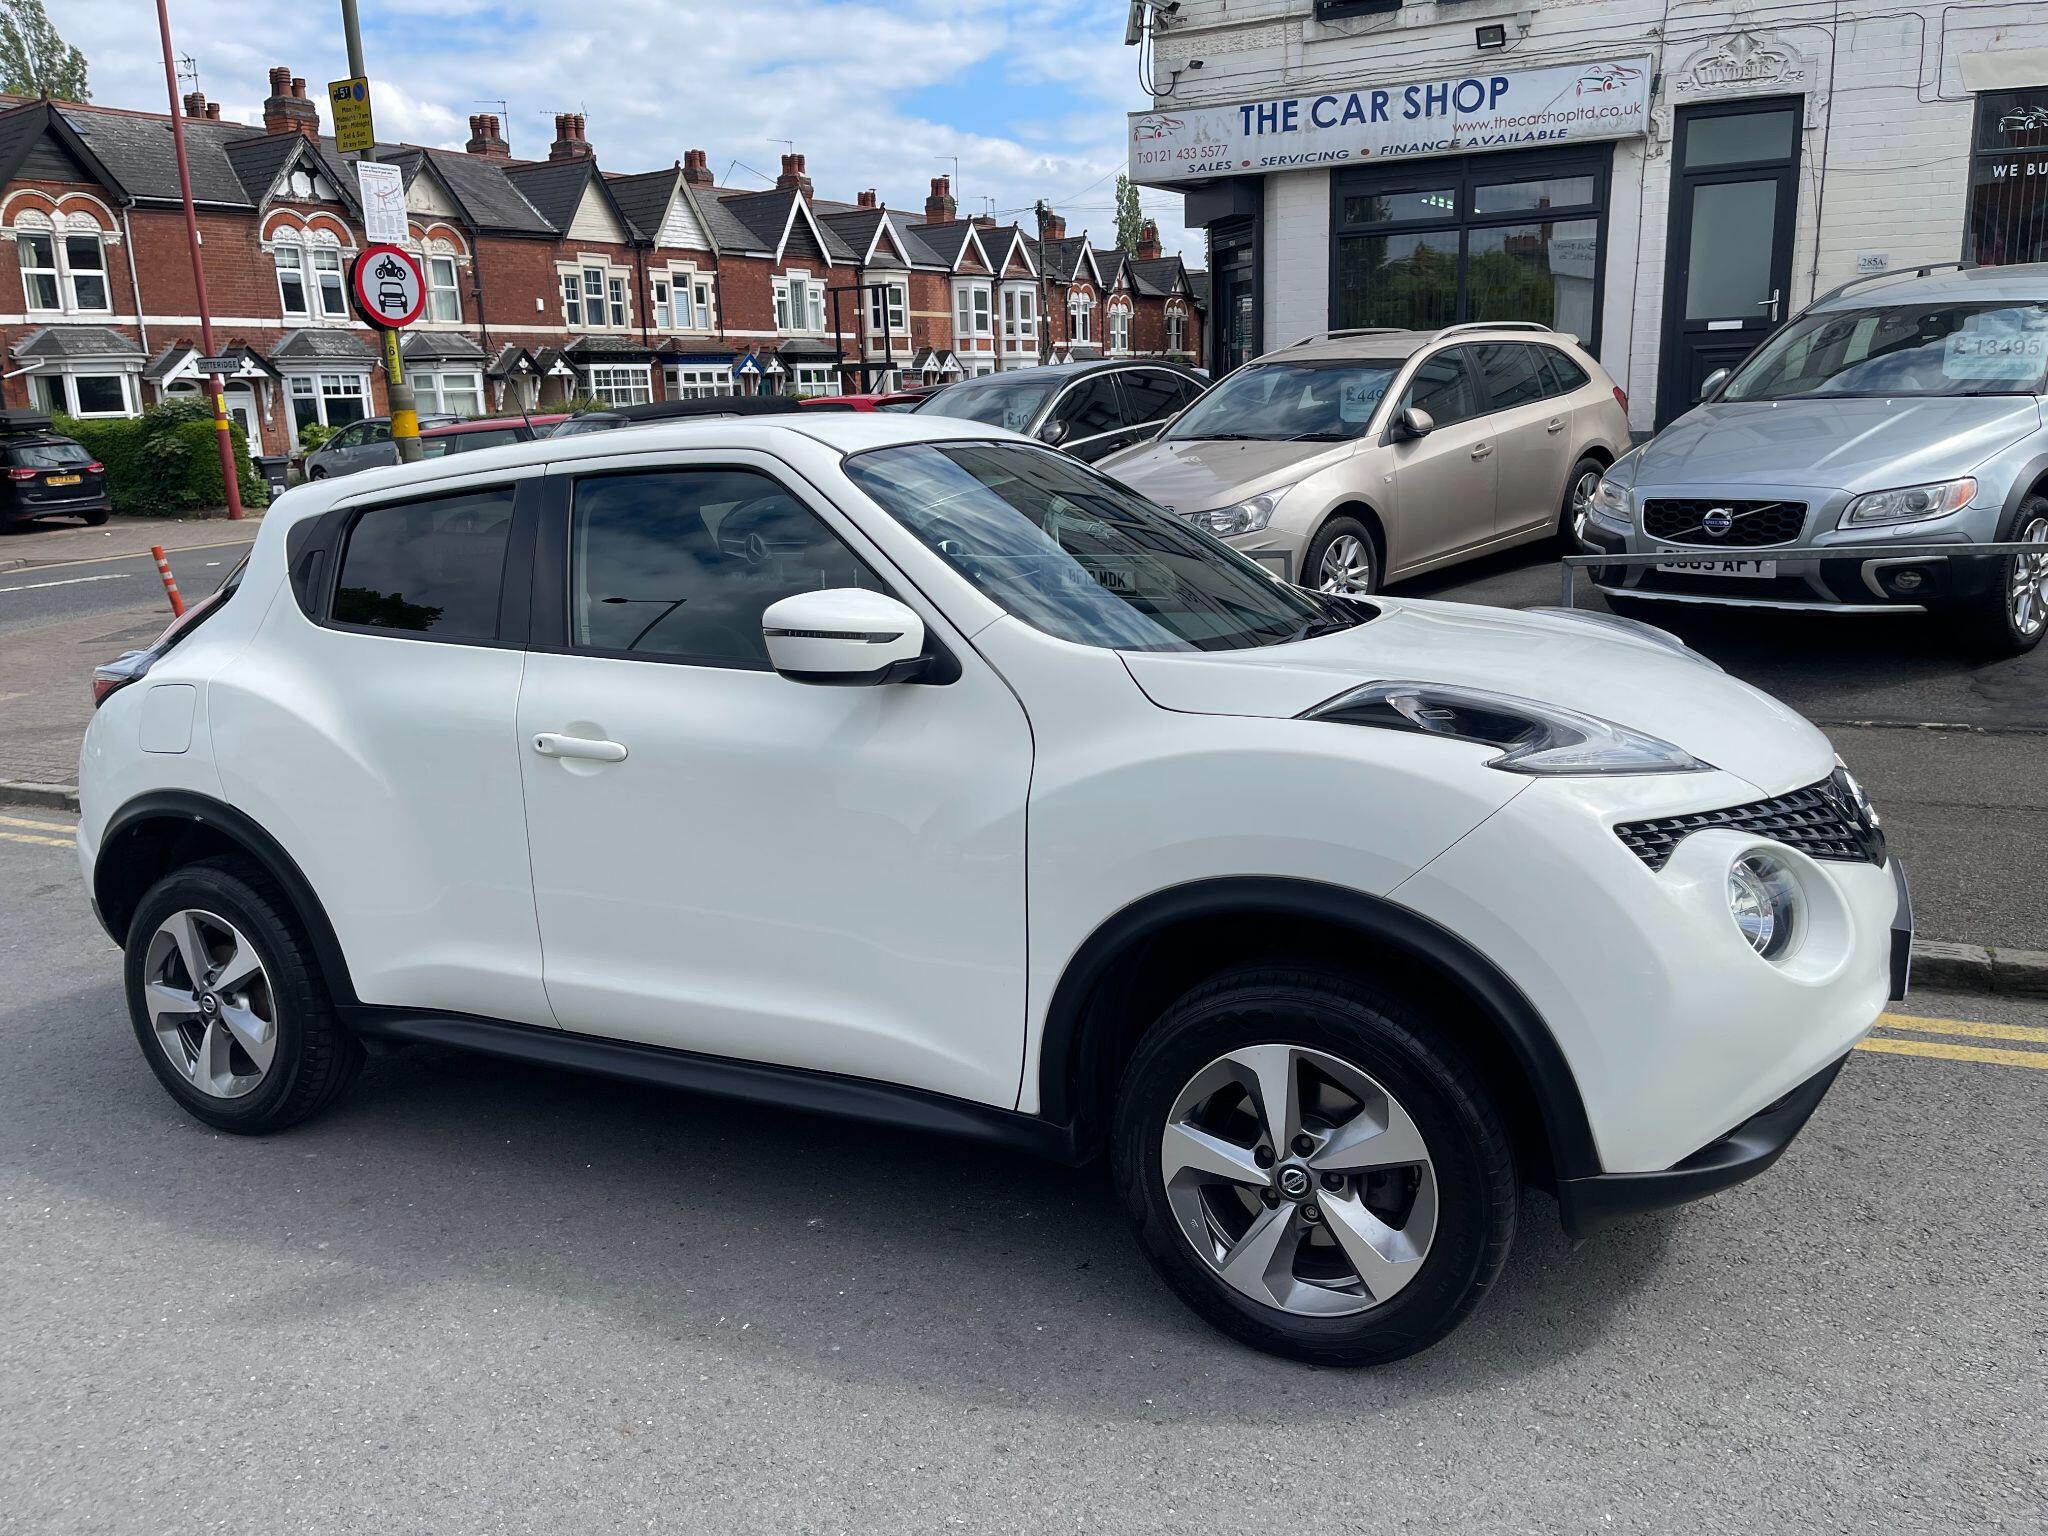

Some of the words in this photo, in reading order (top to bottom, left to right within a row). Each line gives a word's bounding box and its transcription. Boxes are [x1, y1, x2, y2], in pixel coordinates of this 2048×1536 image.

[1240, 100, 1299, 136] THE
[1311, 90, 1390, 129] CAR
[1403, 76, 1509, 120] SHOP
[1453, 101, 1641, 132] www.thecarshopltd.co.uk
[1137, 149, 1171, 164] T:0121
[1176, 147, 1197, 160] 433
[1200, 144, 1228, 159] 5577
[1187, 160, 1232, 173] SALES
[1260, 149, 1350, 167] SERVICING
[1380, 138, 1460, 156] FINANCE
[1466, 128, 1568, 147] AVAILABLE
[1992, 163, 2018, 178] WE
[388, 345, 396, 356] 6
[1722, 560, 1763, 573] AFY
[1099, 570, 1126, 589] MDK
